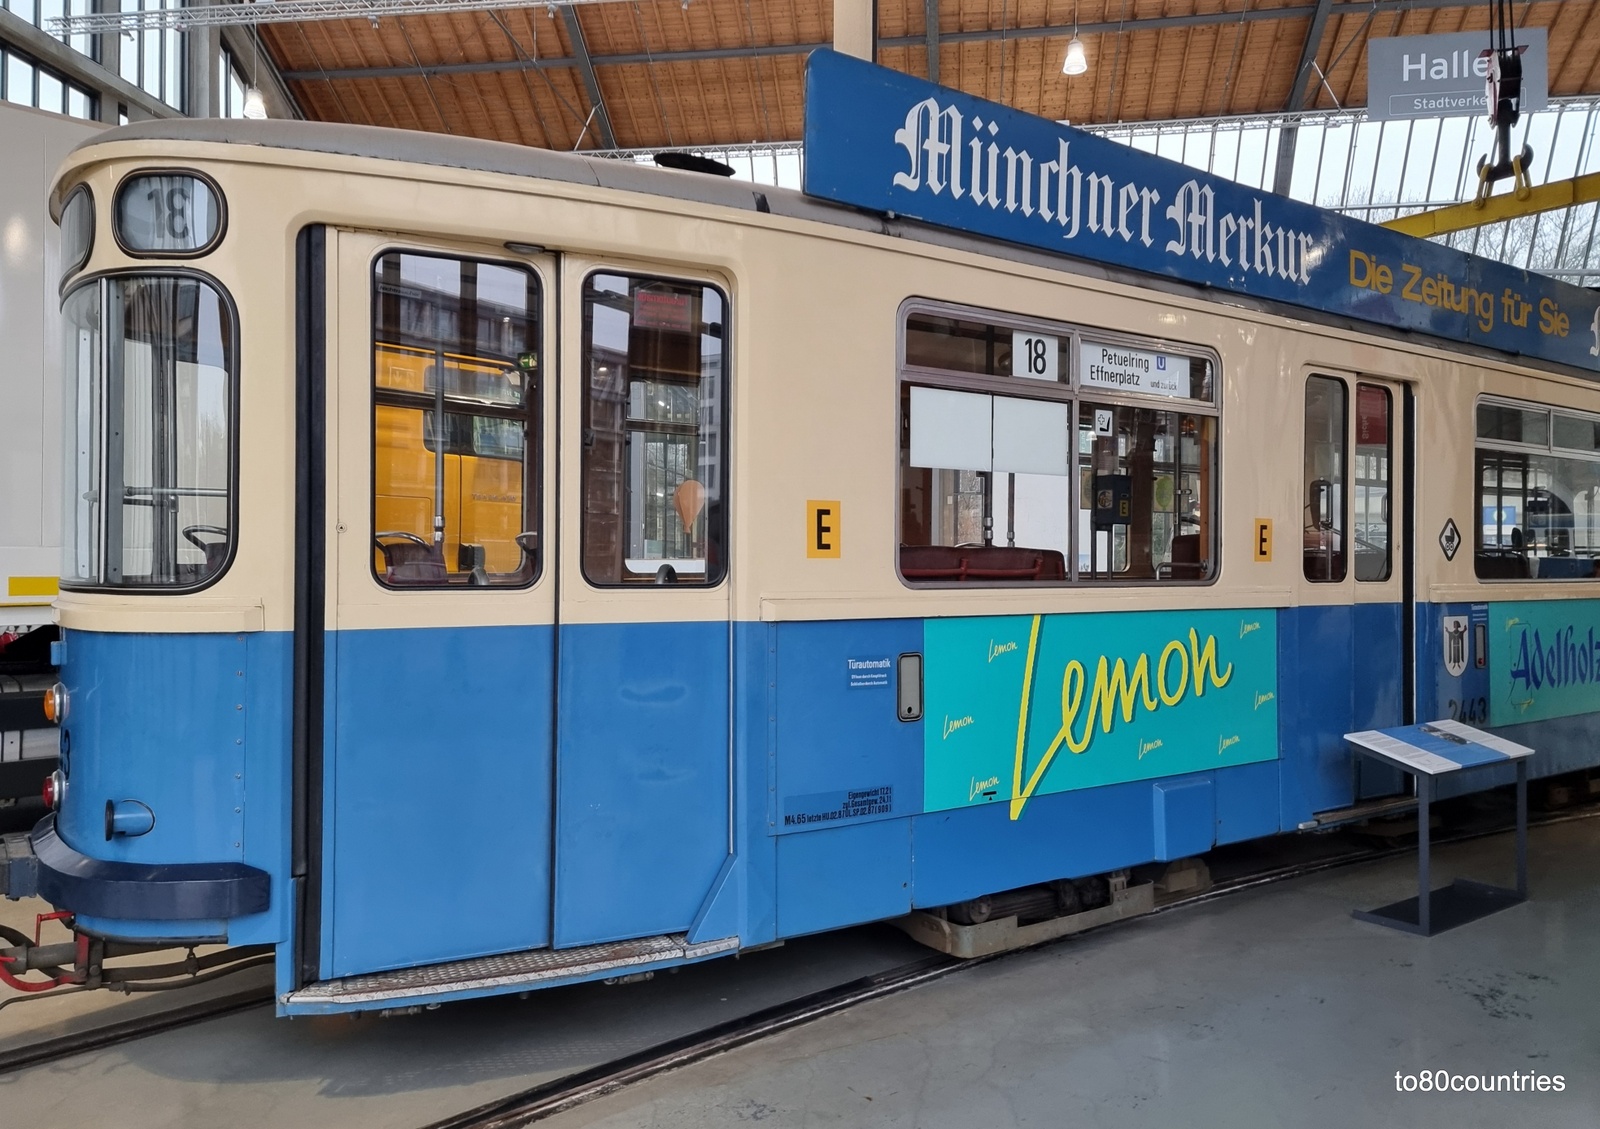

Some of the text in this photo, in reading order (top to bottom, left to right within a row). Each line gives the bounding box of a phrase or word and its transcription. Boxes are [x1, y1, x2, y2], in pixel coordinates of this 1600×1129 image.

[1403, 50, 1488, 81] Halle
[1413, 95, 1488, 110] Stadtverke
[893, 97, 1314, 286] Münchner Merkur
[147, 188, 190, 239] 18
[1350, 249, 1393, 294] Die
[1402, 263, 1494, 333] Zeitung
[1502, 288, 1532, 328] für
[1539, 298, 1569, 337] Sie
[1025, 338, 1046, 375] 18
[1102, 348, 1149, 373] Petuelring
[1090, 365, 1140, 386] Effnerplatz
[1150, 380, 1177, 391] und zuück
[817, 509, 831, 550] E
[1259, 525, 1267, 555] E
[1239, 619, 1261, 639] Lemon
[848, 658, 891, 669] Türautomatik
[988, 639, 1018, 663] Lemon
[1254, 690, 1274, 710] Lemon
[943, 715, 974, 740] Lemon
[1009, 613, 1232, 821] Lemon
[1138, 738, 1163, 760] Lemon
[1218, 734, 1240, 754] Lemon
[969, 776, 1000, 801] Lemon
